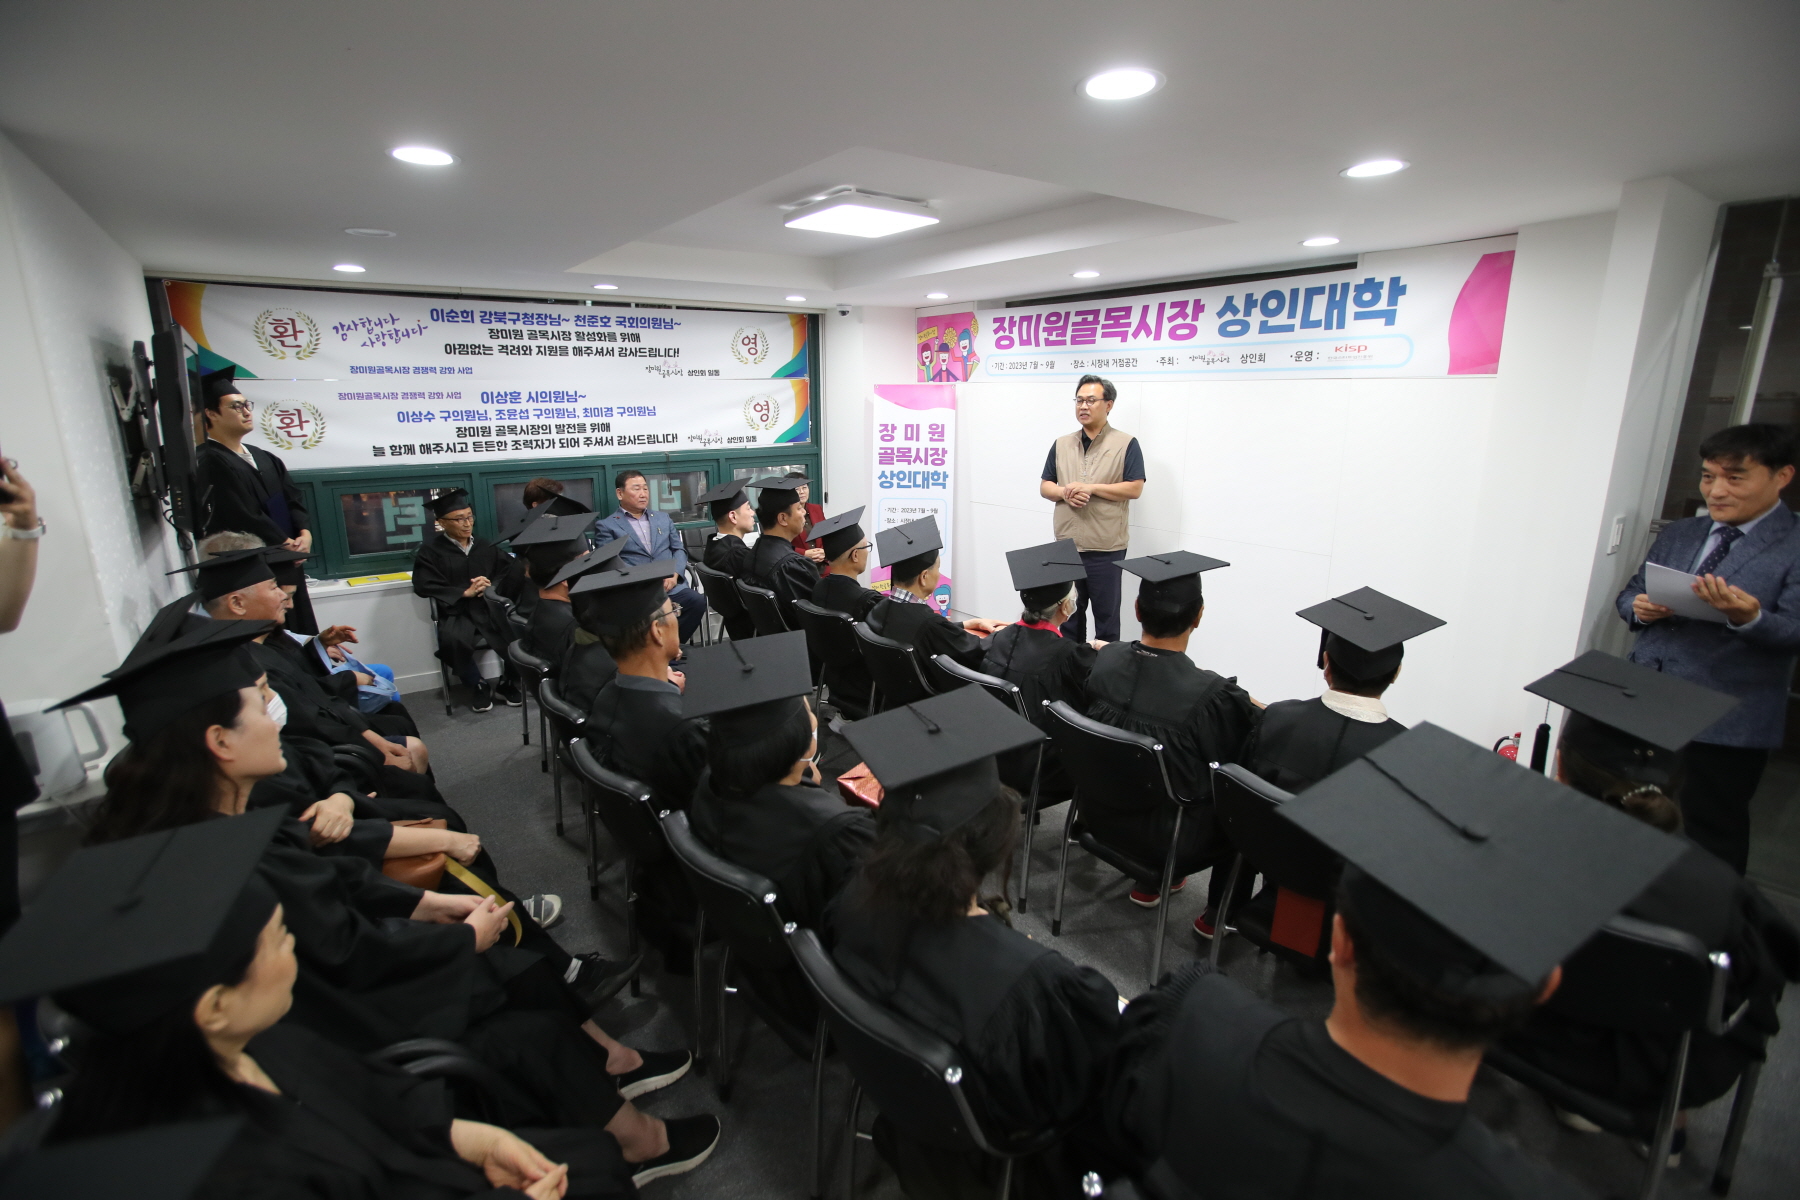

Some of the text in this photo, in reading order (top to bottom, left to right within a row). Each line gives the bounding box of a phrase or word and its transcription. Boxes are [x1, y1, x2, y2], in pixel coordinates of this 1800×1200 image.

[430, 308, 682, 330] 이순희 강북구청장님~ 천준호 국회의원님~
[992, 275, 1408, 350] 장미원골목시장 상인대학
[268, 316, 304, 350] 환
[332, 312, 400, 341] 감사합니다
[488, 328, 641, 343] 장미원 골목시장 활성화를 위해
[444, 343, 680, 358] 아낌없는 격려와 지원을 해주셔서 감사드립니다!
[741, 333, 759, 356] 영
[1008, 361, 1027, 370] 2023년
[1029, 360, 1039, 369] 7월
[1045, 360, 1055, 369] 9월
[1090, 358, 1110, 368] 시장내
[1111, 357, 1138, 368] 거점공간
[1240, 352, 1266, 364] 상인회
[349, 365, 473, 375] 장미원골목시장 경쟁력 강화 사업
[687, 369, 706, 377] 상인회
[707, 369, 720, 377] 일동
[337, 391, 462, 401] 장미원골목시장 경쟁력 강화 사업
[480, 390, 587, 405] 이상훈 시의원님~
[397, 405, 657, 423] 이상수 구의원님, 조윤섭 구의원님, 최미경 구의원님
[753, 400, 770, 423] 영
[274, 407, 310, 439] 환
[455, 422, 611, 438] 장미원 골목시장의 발전을 위해
[372, 432, 678, 457] 늘 함께 해주시고 든든한 조력자가 되어 주셔서 감사드립니다!
[745, 435, 757, 443] 일동
[878, 446, 948, 467] 골목시장
[877, 470, 949, 489] 상인대학
